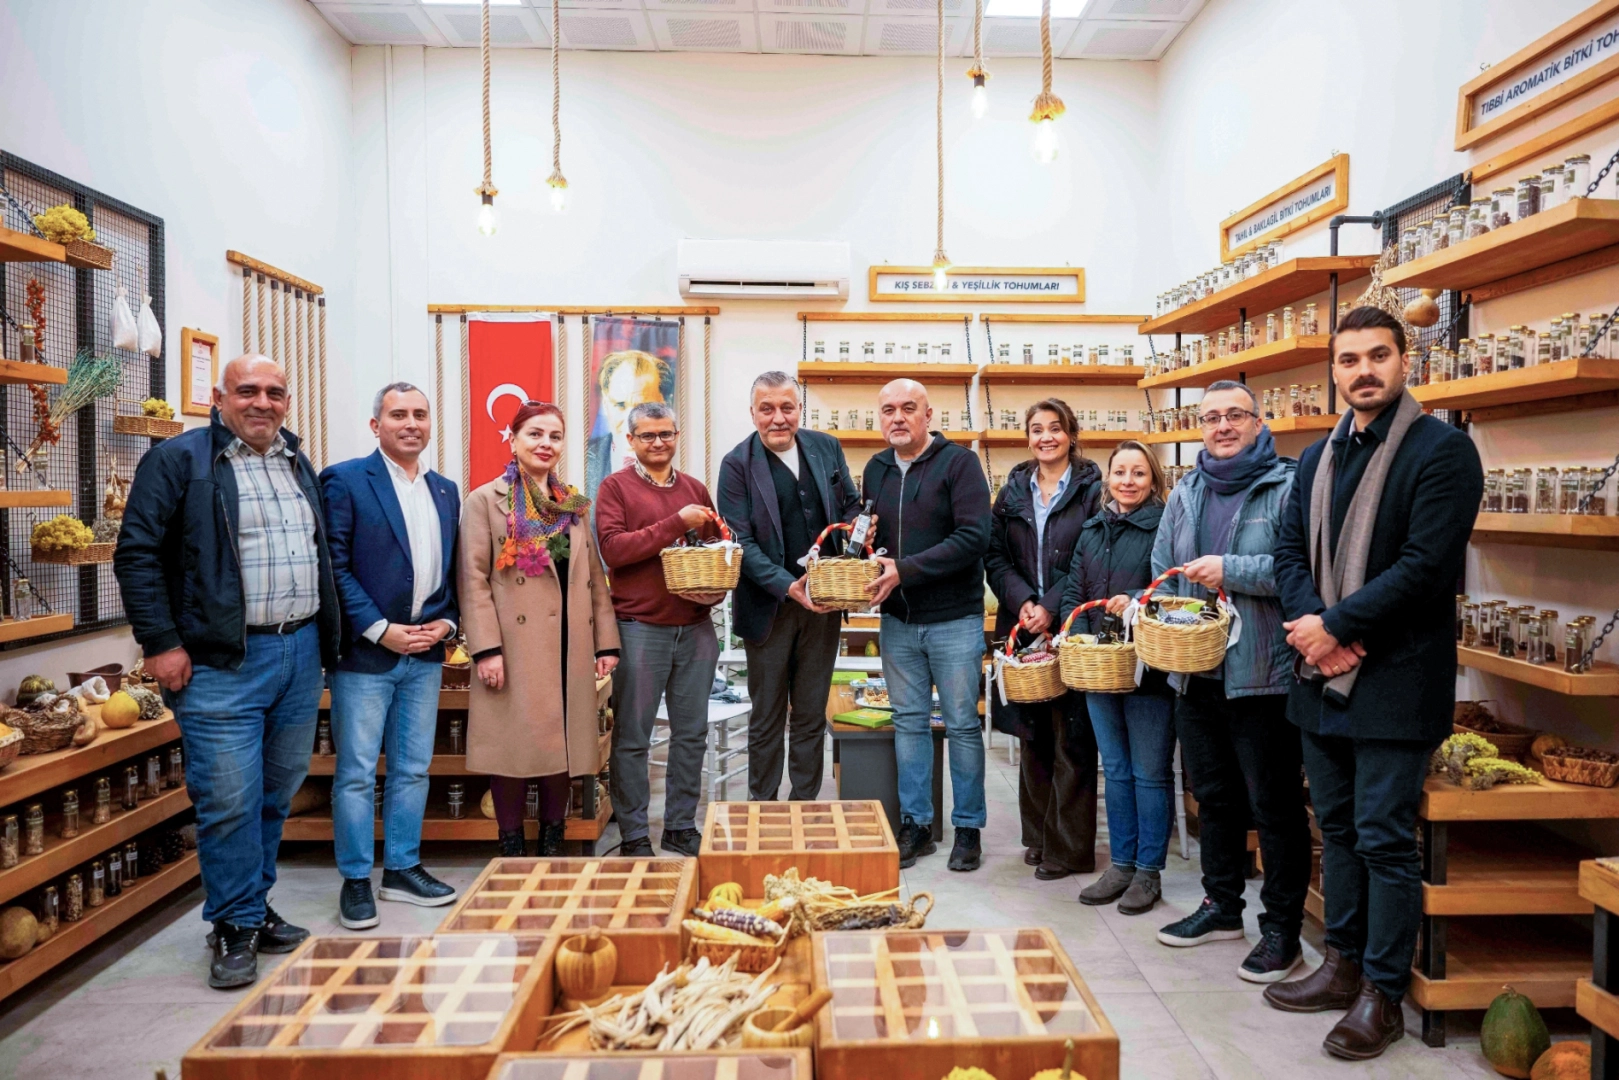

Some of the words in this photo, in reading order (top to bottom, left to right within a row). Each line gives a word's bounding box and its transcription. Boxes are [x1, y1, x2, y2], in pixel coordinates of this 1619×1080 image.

[1481, 89, 1504, 116] TIBBİ
[1505, 61, 1561, 103] AROMATİK
[1563, 39, 1594, 71] BİTKİ
[1279, 201, 1294, 222] BİTKİ
[1294, 184, 1332, 212] TOHUMLARI
[894, 281, 910, 291] KIŞ
[912, 280, 949, 290] SEBZİ
[951, 281, 959, 290] &
[962, 280, 1001, 291] YEŞİLLİK
[1004, 281, 1060, 291] TOHUMLARI
